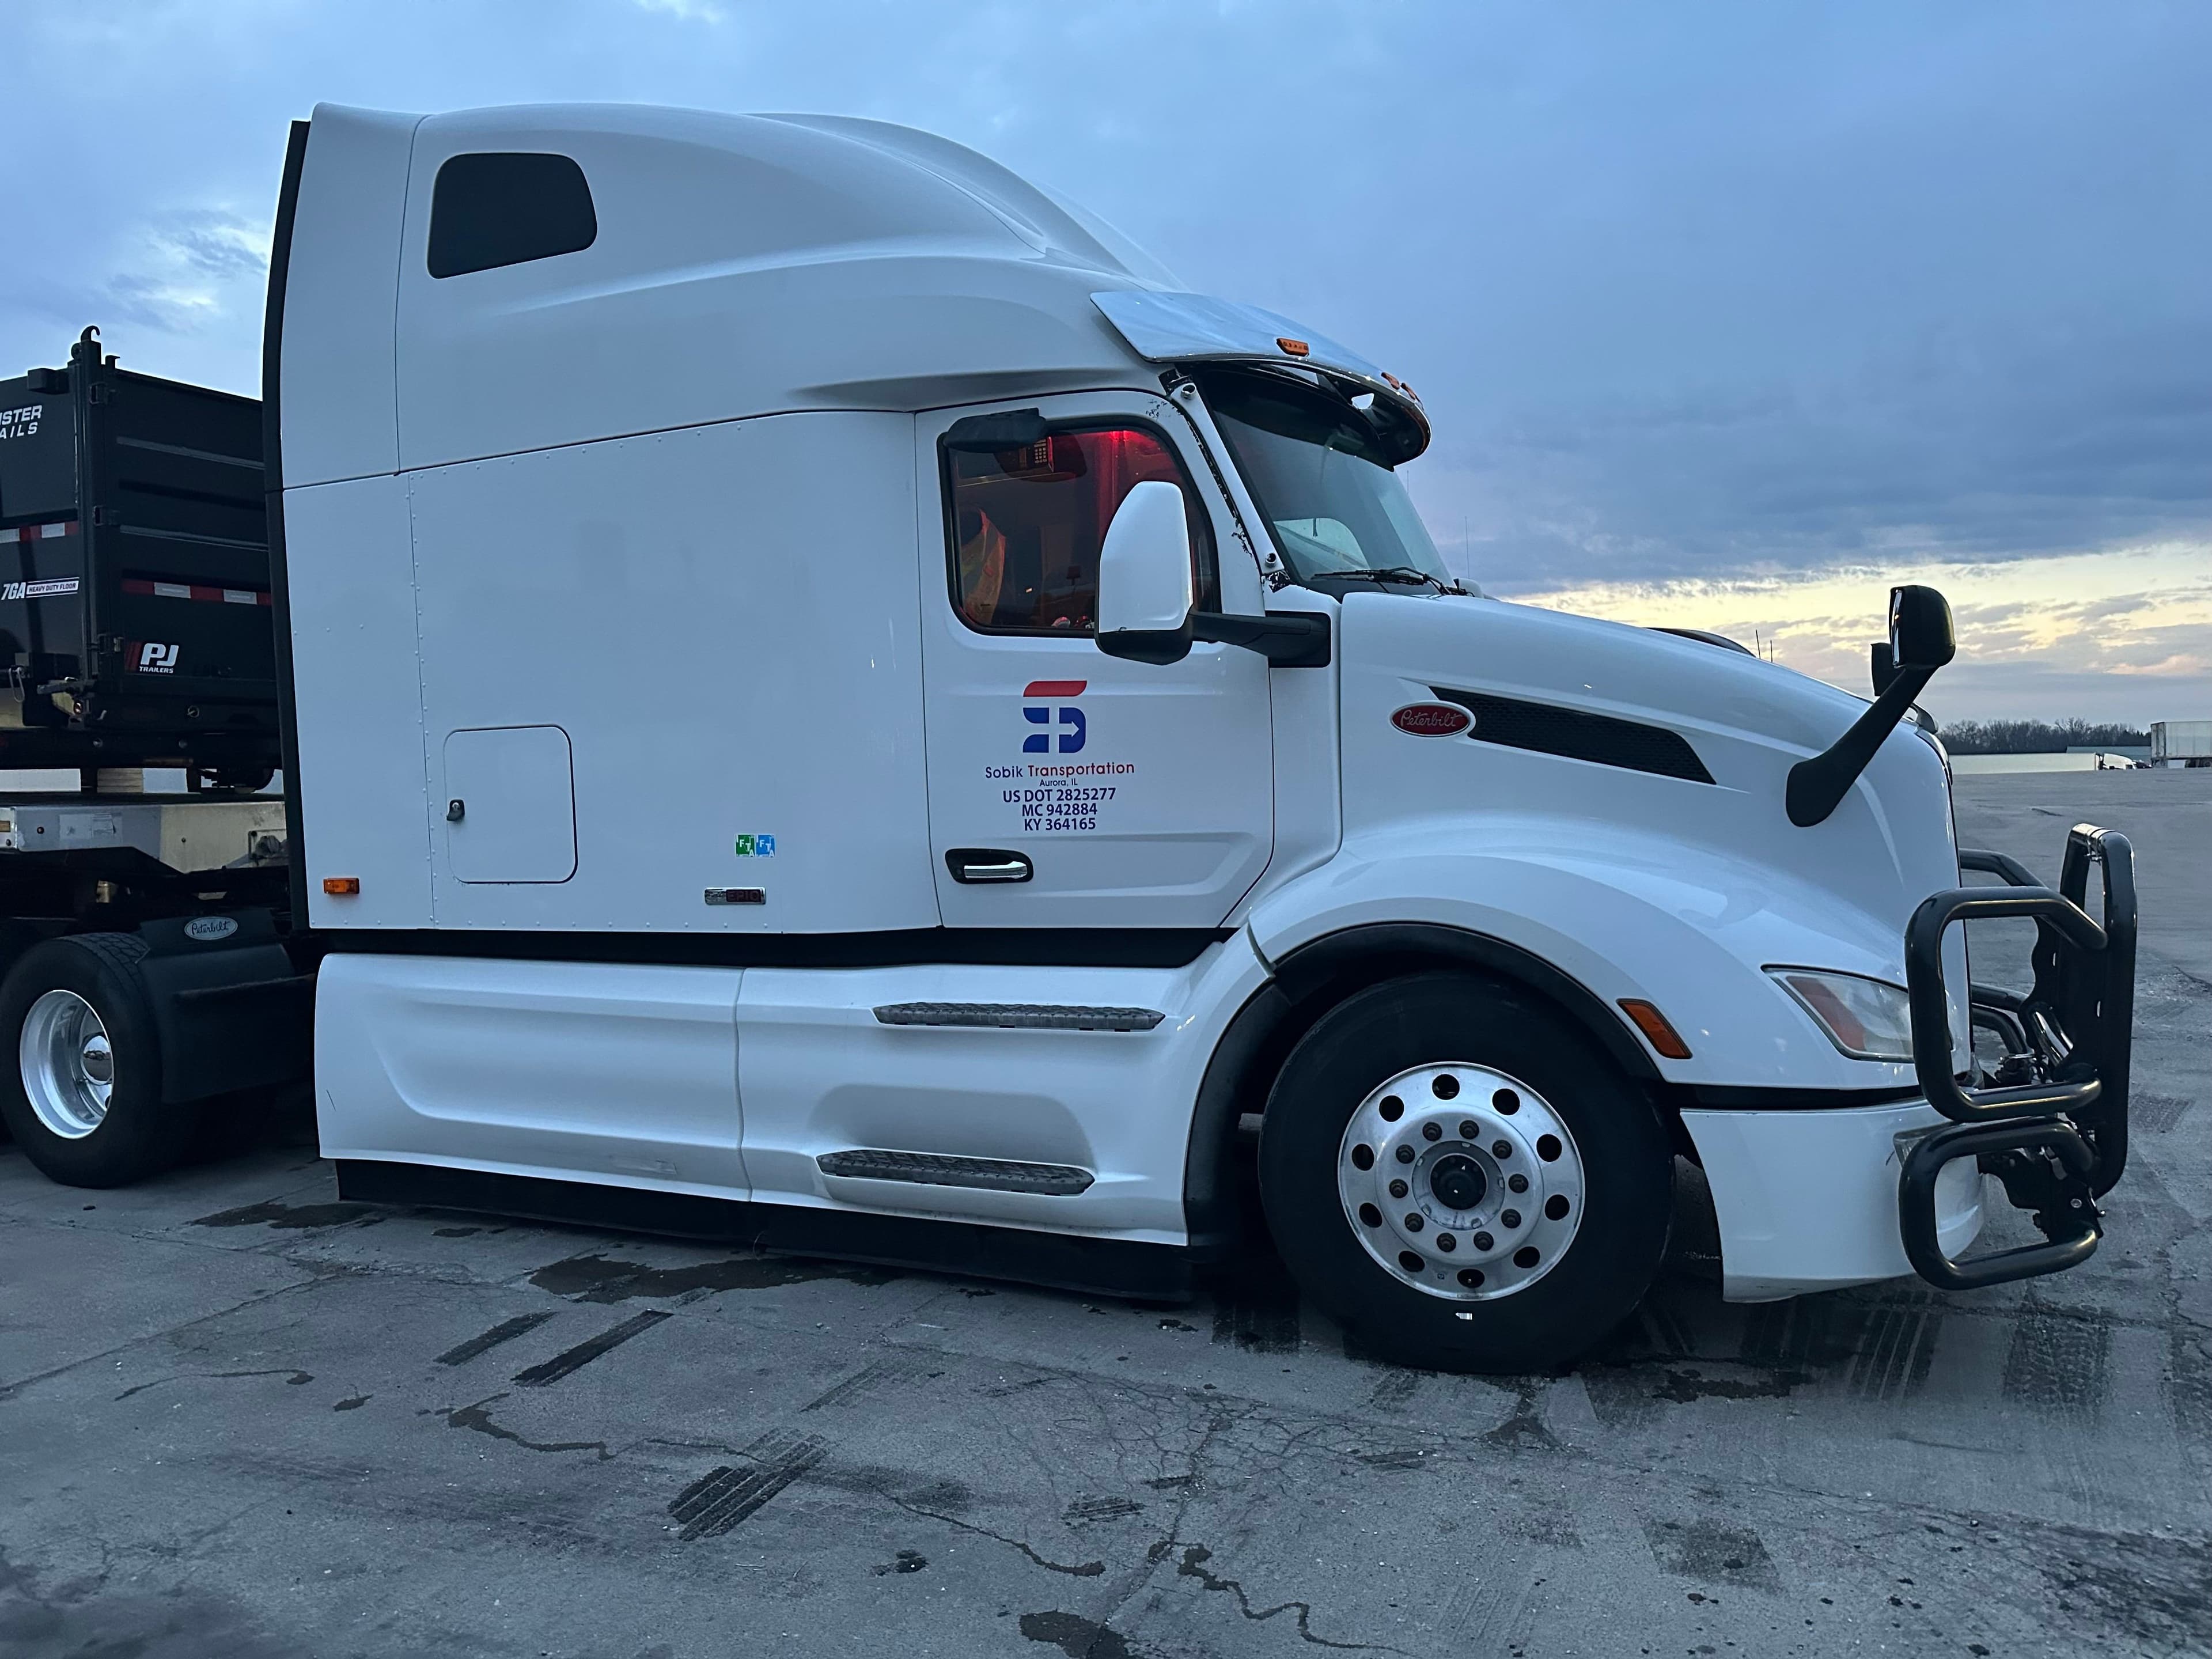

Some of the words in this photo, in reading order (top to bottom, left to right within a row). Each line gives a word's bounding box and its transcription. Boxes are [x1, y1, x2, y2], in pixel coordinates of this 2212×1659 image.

[0, 405, 43, 426] STER
[1, 582, 26, 600] 7GA
[141, 643, 179, 666] PJ
[1400, 710, 1462, 727] Peterbilt
[986, 766, 1023, 778] Sobik
[1028, 762, 1134, 778] Transportation
[1039, 779, 1069, 787] Aurora,
[1003, 790, 1020, 802] US
[1024, 789, 1052, 802] DOT
[1056, 787, 1116, 801] 2825277
[1022, 804, 1043, 816] MC
[1046, 803, 1097, 816] 942884
[1024, 819, 1041, 831] KY
[1046, 818, 1096, 830] 364165
[736, 834, 755, 857] IFTA
[756, 834, 775, 857] IFTA
[191, 921, 230, 935] Peterbilt
